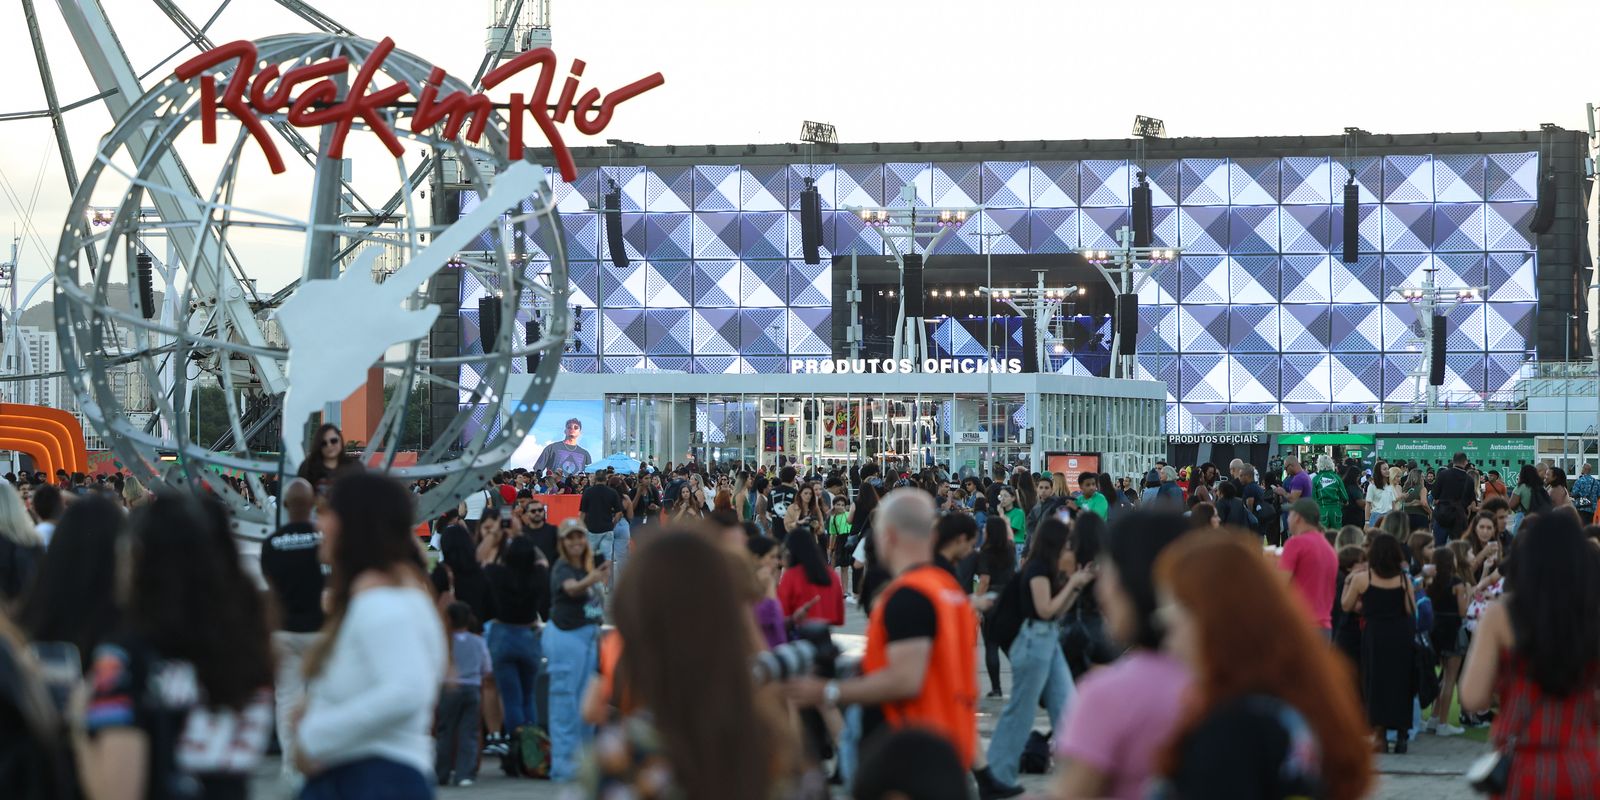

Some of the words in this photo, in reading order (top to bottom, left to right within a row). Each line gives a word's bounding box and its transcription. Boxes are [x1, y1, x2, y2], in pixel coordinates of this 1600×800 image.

[174, 36, 410, 174] Rock
[410, 66, 493, 144] in
[481, 46, 665, 183] Rio
[791, 358, 914, 374] PRODUTOS
[923, 358, 1022, 374] OFICIAIS
[1169, 434, 1218, 443] PRODUTOS
[1219, 434, 1258, 443] OFICIAIS
